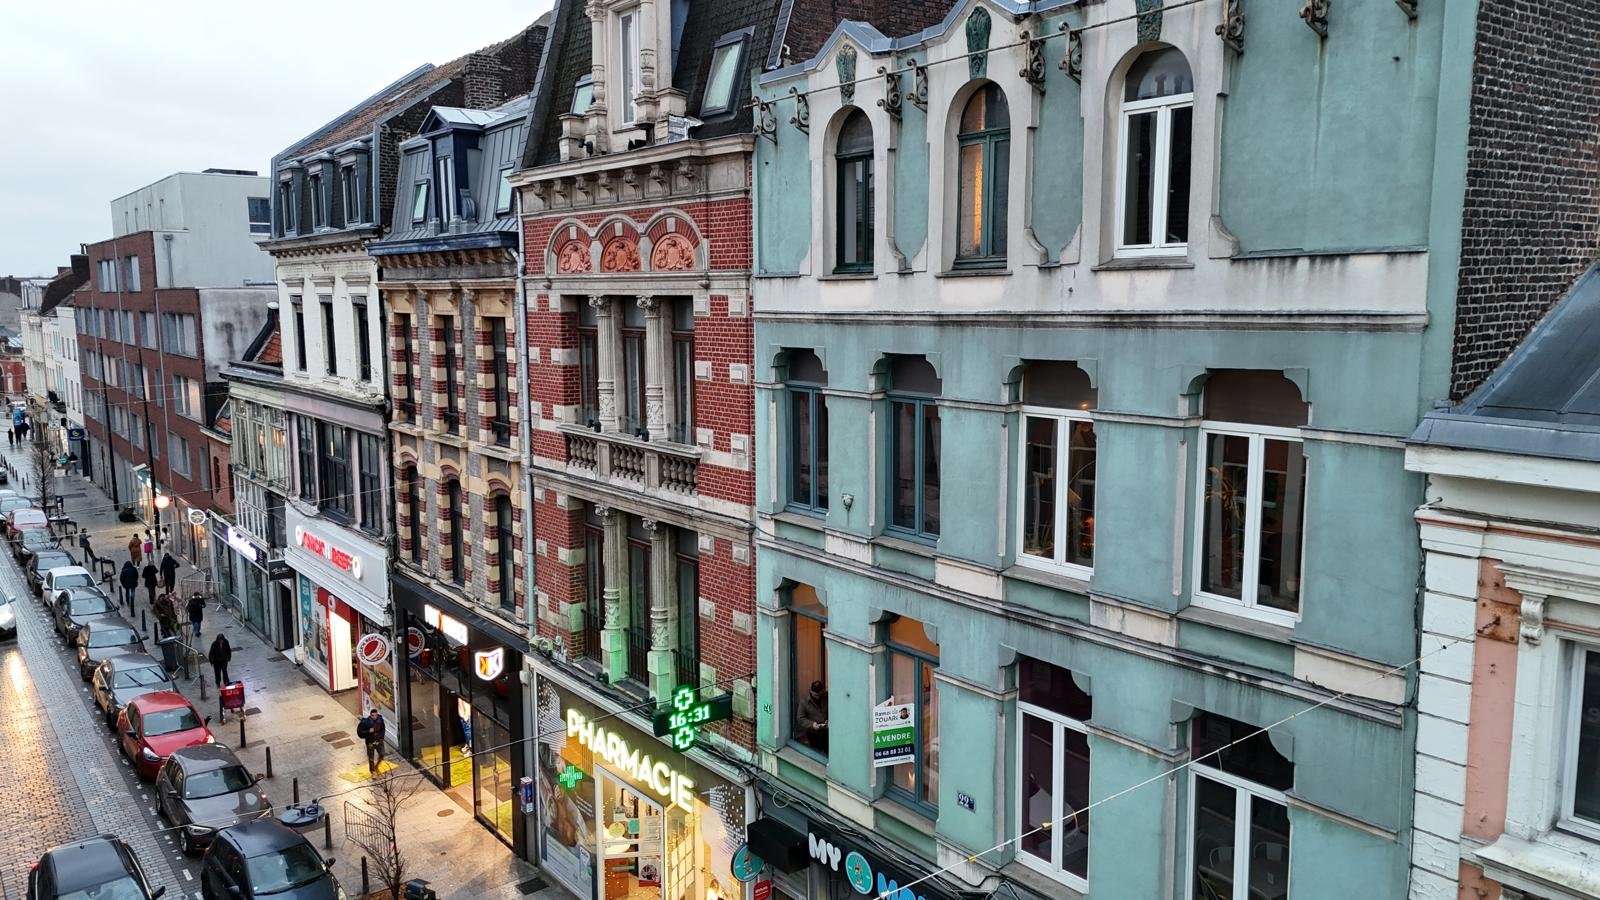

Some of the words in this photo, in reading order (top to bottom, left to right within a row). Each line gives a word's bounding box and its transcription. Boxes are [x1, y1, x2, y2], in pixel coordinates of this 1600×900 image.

[669, 705, 711, 730] 16:31
[881, 732, 911, 742] VENDRE
[566, 708, 695, 814] PHARMACIE
[958, 793, 969, 807] 22
[808, 832, 842, 872] MY
